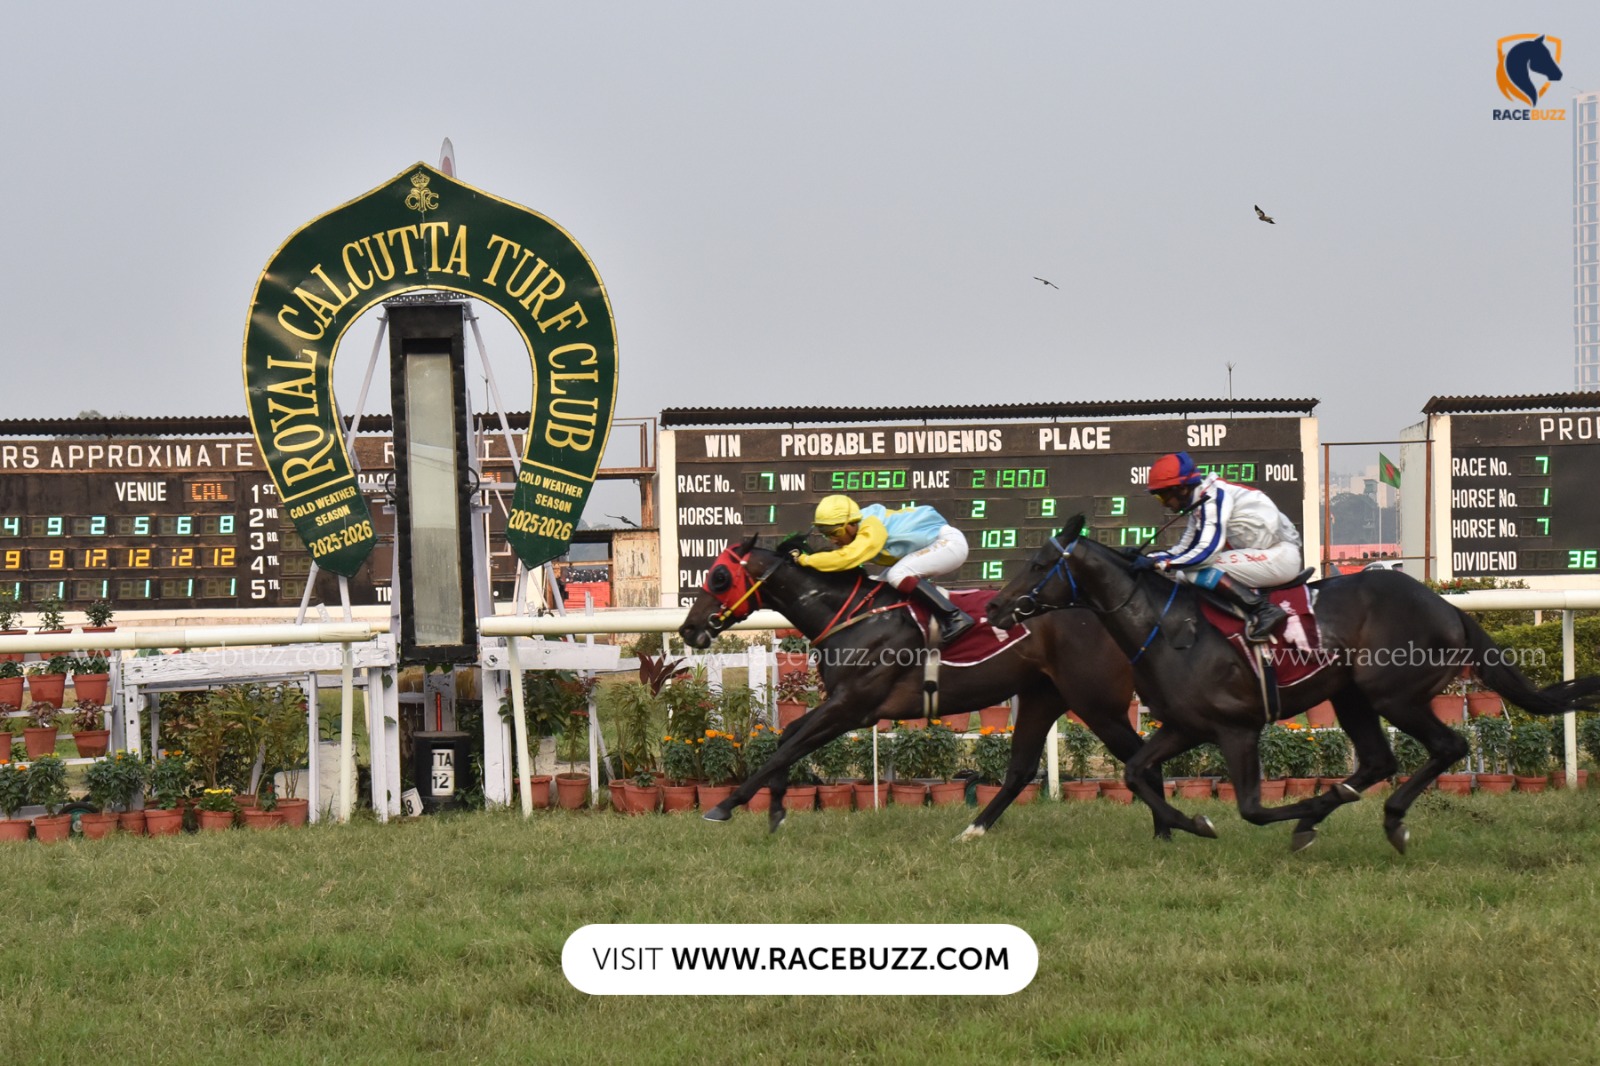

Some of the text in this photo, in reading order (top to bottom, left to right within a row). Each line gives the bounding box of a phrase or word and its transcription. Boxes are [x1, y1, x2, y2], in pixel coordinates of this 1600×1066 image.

[267, 221, 599, 487] ROYAL CALCUTTA TURF CLUB
[1540, 417, 1600, 441] PRO
[705, 424, 1227, 458] WIN PROBABLE DIVIDENDS PLACE SHP
[51, 443, 253, 468] APPROXIMATE
[1452, 456, 1549, 477] RACE No. 7
[519, 470, 542, 486] COLD
[542, 477, 584, 498] WEATHER
[678, 474, 711, 493] RACE
[714, 474, 736, 493] No.
[760, 472, 774, 491] 7
[779, 474, 806, 491] WIN
[913, 470, 950, 489] PLACE
[1265, 464, 1298, 482] POOL
[115, 481, 229, 502] VENUE CAL
[290, 486, 357, 519] COLD WEATHER
[535, 493, 572, 513] SEASON
[1452, 487, 1549, 509] HORSE No. 1
[315, 504, 351, 527] SEASON
[678, 496, 1125, 526] HORSE No. 1 2 9 3
[4, 515, 234, 536] 4 9 2 5 6 8
[508, 508, 573, 541] 2025-2026
[1452, 517, 1550, 539] HORSE No. 7
[309, 519, 373, 558] 2025-2026
[679, 538, 704, 558] WIN
[981, 529, 1016, 548] 103
[1121, 527, 1156, 546] 174
[5, 550, 21, 569] 9
[48, 549, 65, 568] 9
[128, 548, 151, 568] 12
[213, 547, 236, 567] 12
[1453, 550, 1518, 572] DIVIDEND
[982, 561, 1003, 579] 15
[58, 581, 64, 599] 1
[102, 580, 108, 599] 1
[144, 579, 151, 598] 1
[187, 578, 193, 597] 1
[230, 577, 236, 596] 1
[406, 799, 414, 815] 8
